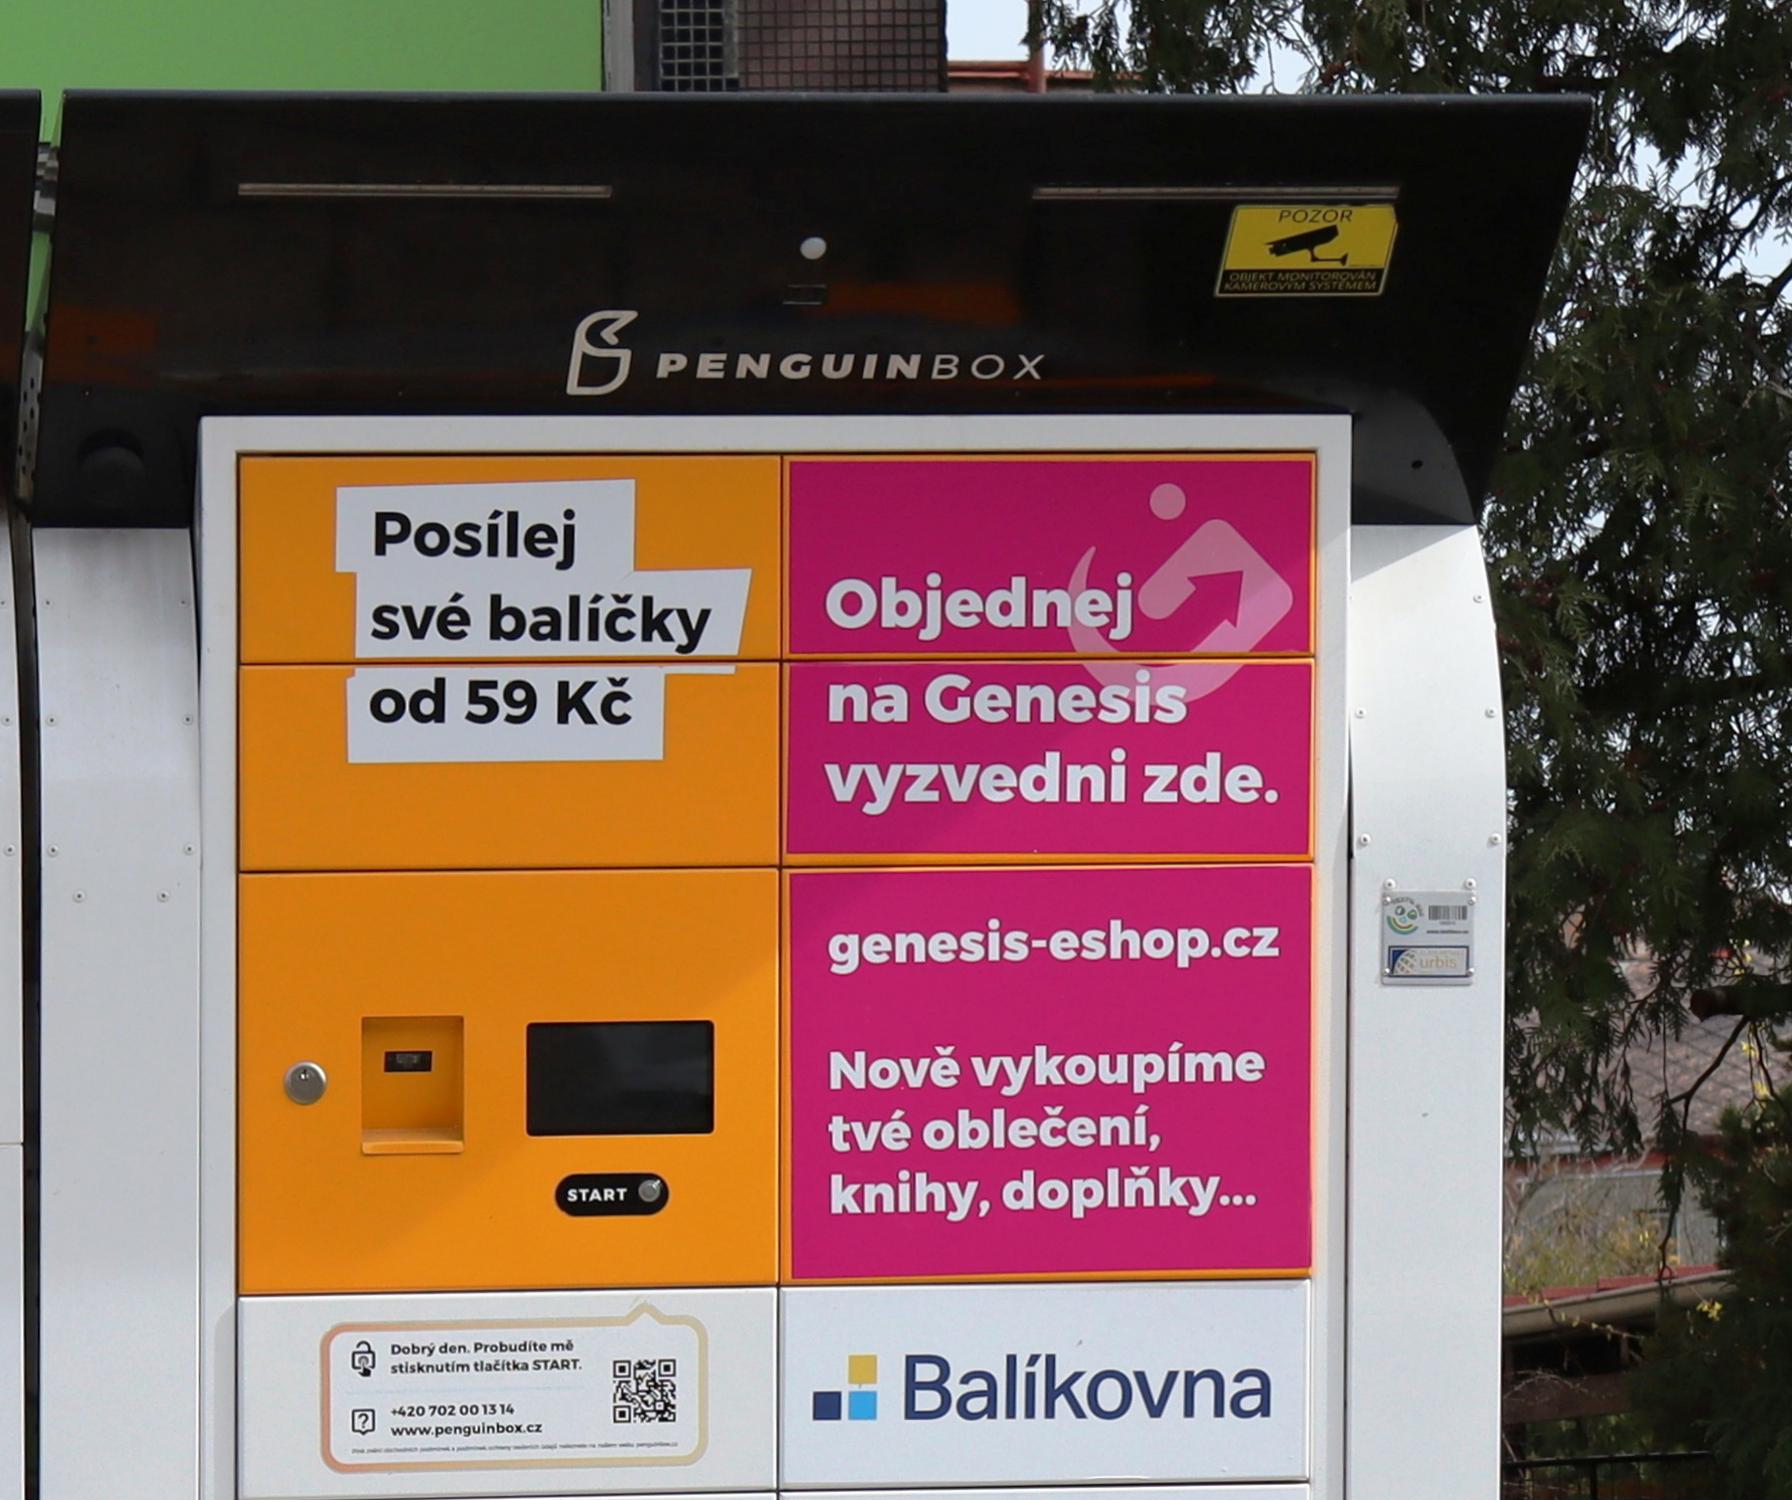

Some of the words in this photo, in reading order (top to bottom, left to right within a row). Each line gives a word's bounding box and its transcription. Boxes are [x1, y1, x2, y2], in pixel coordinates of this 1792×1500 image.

[1278, 209, 1353, 223] POZOR
[1229, 272, 1273, 282] OBJEKT
[1277, 270, 1376, 281] MONITOROVÁN
[655, 353, 1048, 382] PENGUINBOX
[373, 508, 577, 571] Posílej
[370, 592, 471, 640] své
[489, 593, 712, 655] balíčky
[825, 572, 1133, 641] Objednej
[369, 677, 447, 724] od
[465, 680, 538, 724] 59
[556, 676, 633, 725] Kč
[828, 683, 910, 723] na
[924, 668, 1188, 724] Genesis
[824, 747, 1127, 815] vyzvedni
[1143, 751, 1279, 804] zde.
[827, 918, 1280, 975] genesis-eshop.cz
[828, 1046, 960, 1090] Nově
[971, 1041, 1266, 1097] vykoupíme
[828, 1109, 911, 1152] tvé
[922, 1104, 1161, 1152] oblečení,
[567, 1187, 628, 1203] START
[830, 1170, 991, 1222] knihy,
[1001, 1165, 1257, 1219] doplňky...
[390, 1343, 436, 1358] Dobrý
[439, 1341, 471, 1355] den.
[551, 1339, 574, 1352] mě
[390, 1360, 470, 1374] stisknutím
[473, 1358, 529, 1373] tlačítka
[532, 1358, 583, 1372] START.
[390, 1405, 426, 1418] +420
[429, 1404, 457, 1417] 702
[459, 1404, 480, 1416] 00
[482, 1404, 498, 1416] 13
[500, 1403, 515, 1415] 14
[903, 1353, 1272, 1421] Balíkovna
[390, 1420, 543, 1438] www.penguinbox.cz
